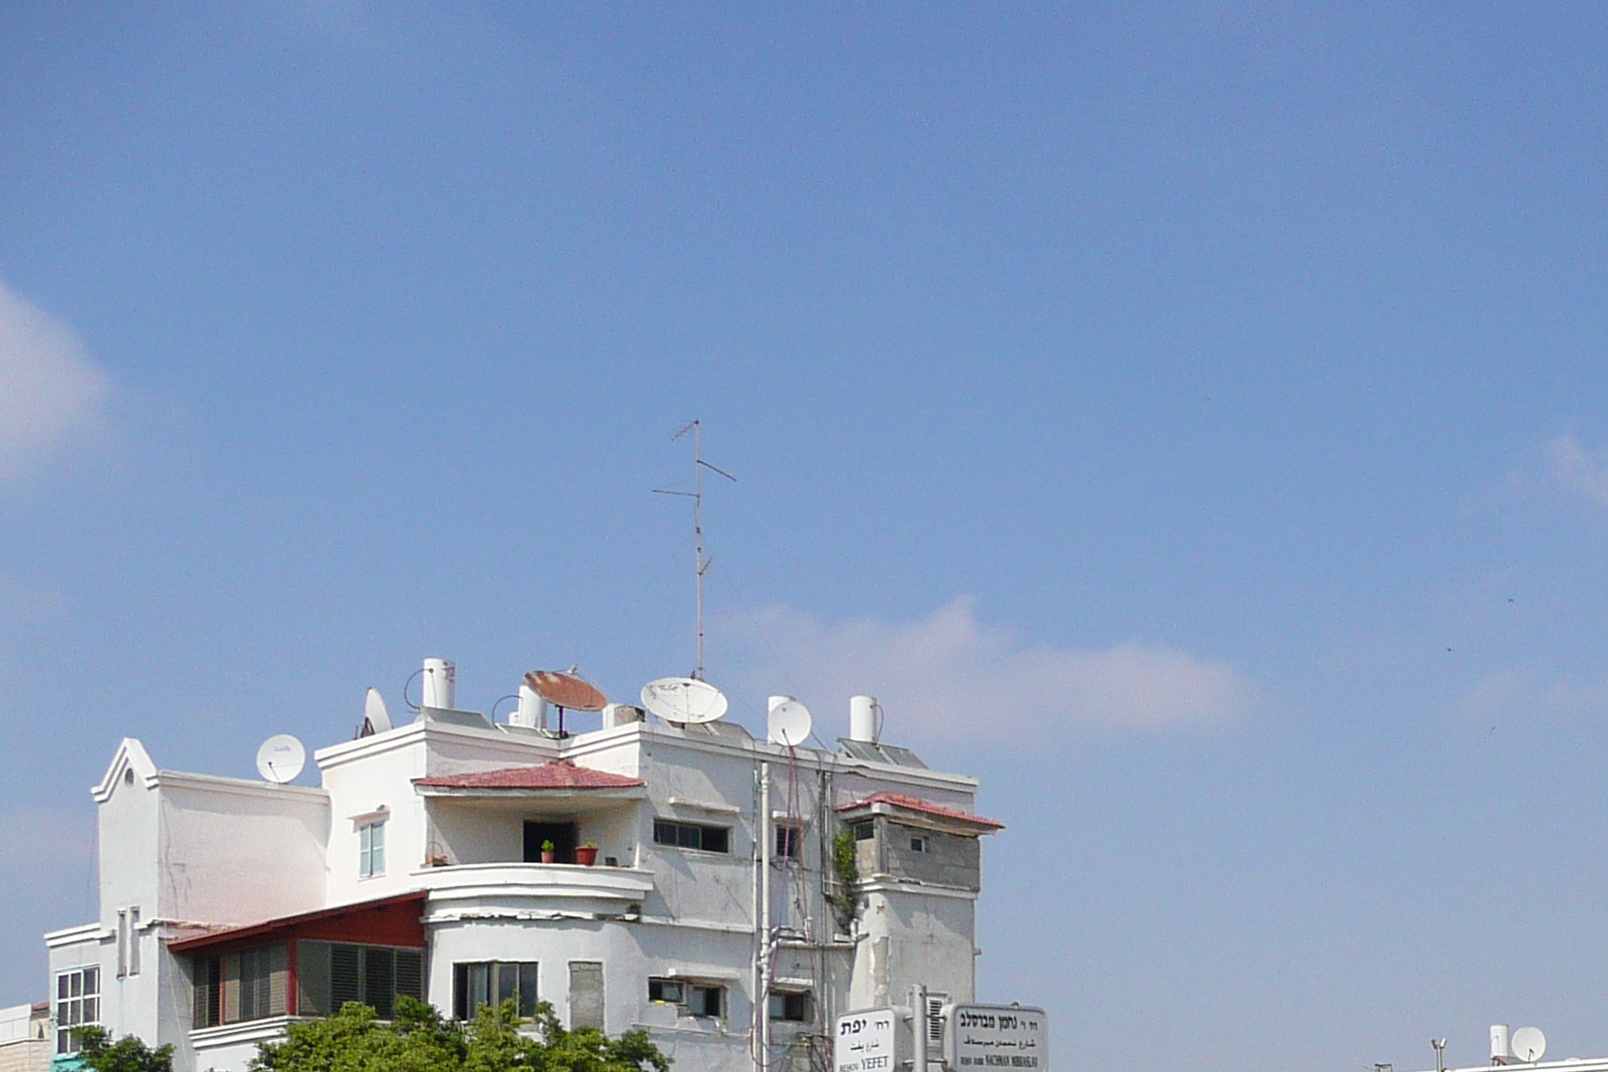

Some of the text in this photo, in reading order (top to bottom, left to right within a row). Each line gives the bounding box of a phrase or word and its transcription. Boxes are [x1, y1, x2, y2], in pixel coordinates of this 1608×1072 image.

[840, 1018, 867, 1036] יפת
[960, 1011, 995, 1029] מברסלב
[998, 1015, 1018, 1031] נחמן
[861, 1055, 889, 1070] YEFET
